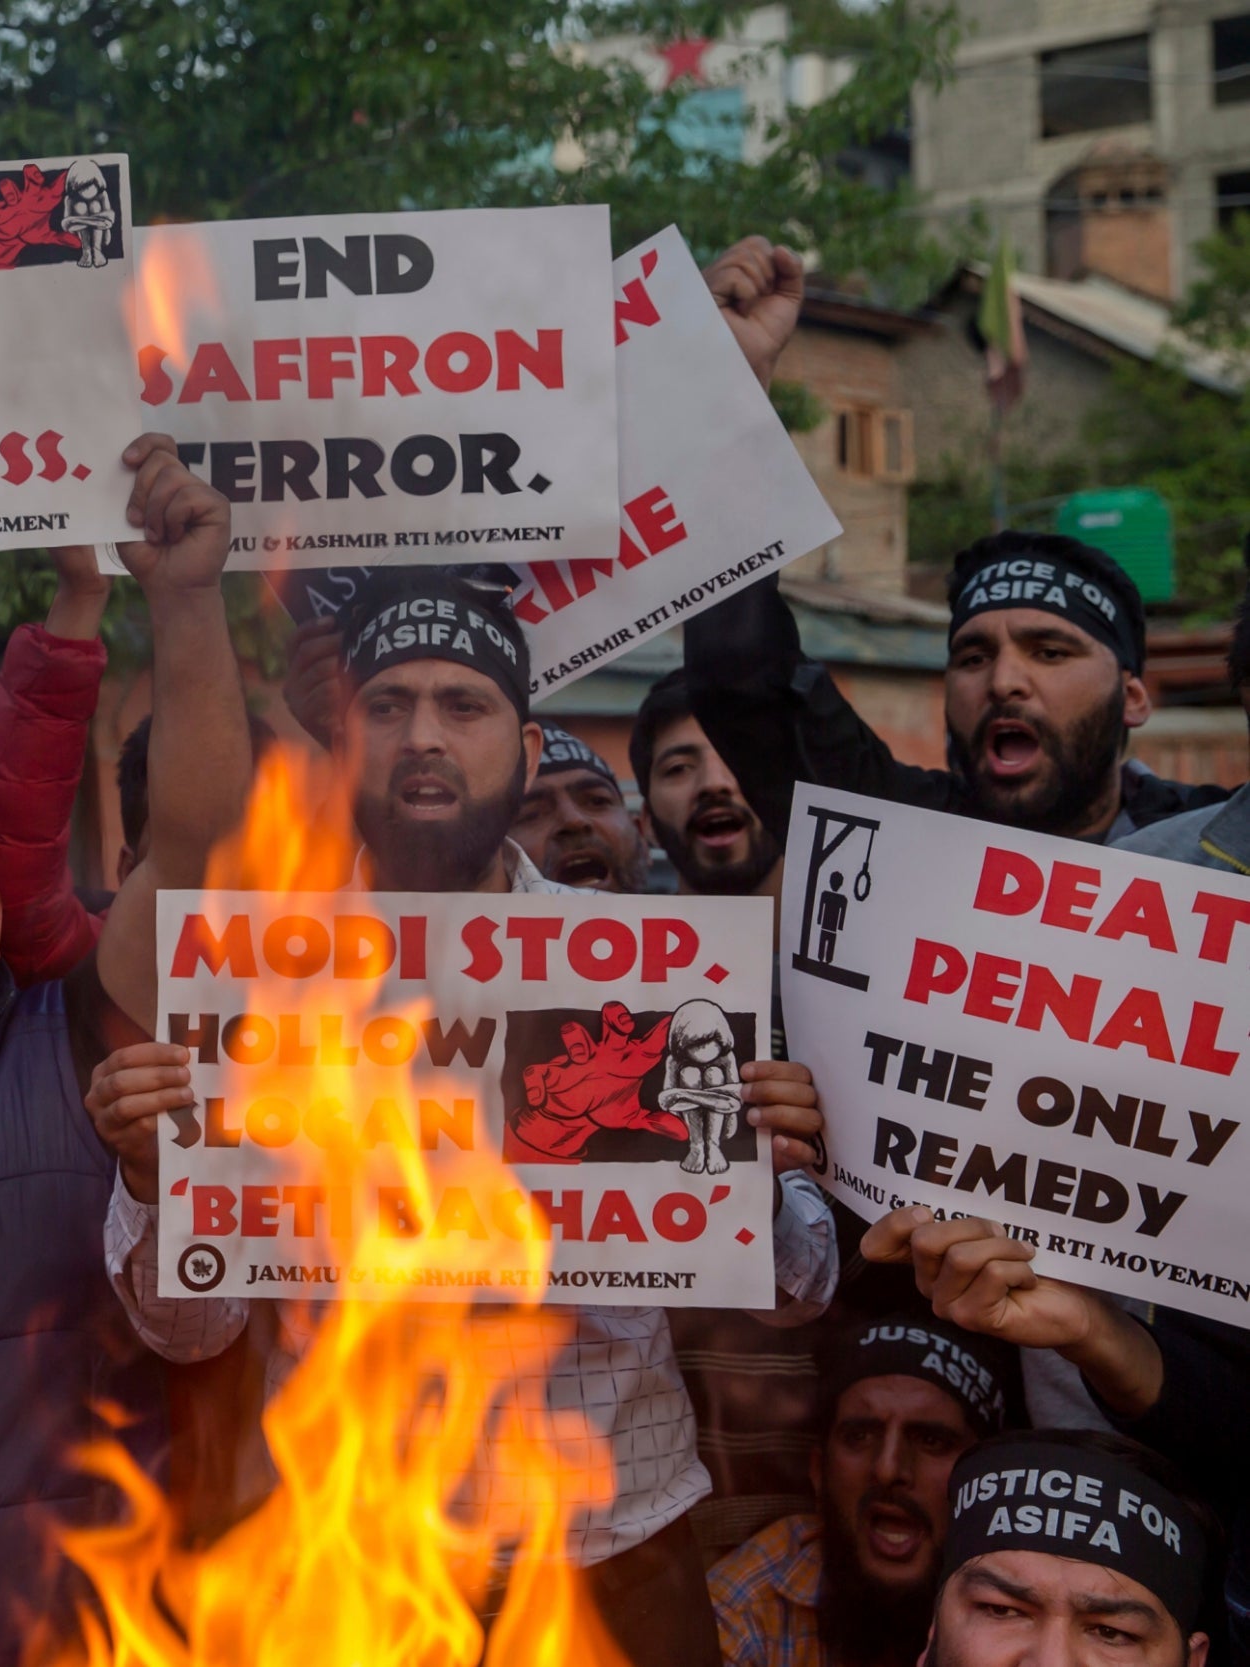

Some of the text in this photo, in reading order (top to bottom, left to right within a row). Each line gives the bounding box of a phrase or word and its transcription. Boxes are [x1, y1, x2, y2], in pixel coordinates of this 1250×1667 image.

[253, 234, 434, 302] END
[137, 329, 564, 407] SAFFRON
[262, 536, 281, 551] &
[285, 531, 388, 551] KASHMIR
[394, 530, 430, 547] RTI
[434, 526, 565, 546] MOVEMENT
[542, 628, 634, 685] KASHMIR
[635, 606, 671, 634] RTI
[671, 539, 786, 614] MOVEMENT
[968, 580, 1067, 609] ASIFA
[1064, 572, 1117, 621] FOR
[374, 621, 474, 661] ASIFA
[467, 610, 517, 666] FOR
[972, 846, 1250, 970] DEAT
[170, 914, 730, 985] MODI STOP.
[167, 1013, 496, 1068] HOLLOW
[903, 937, 1250, 1077] PENAL
[863, 1031, 1240, 1167] THE ONLY
[833, 1163, 885, 1204] JAMMU
[1047, 1234, 1095, 1260] RTI
[873, 1117, 1187, 1237] REMEDY
[246, 1265, 341, 1286] JAMMU
[547, 1270, 696, 1290] MOVEMENT
[858, 1325, 994, 1396] JUSTICE
[953, 1469, 1182, 1555] JUSTICE FOR
[986, 1505, 1121, 1555] ASIFA
